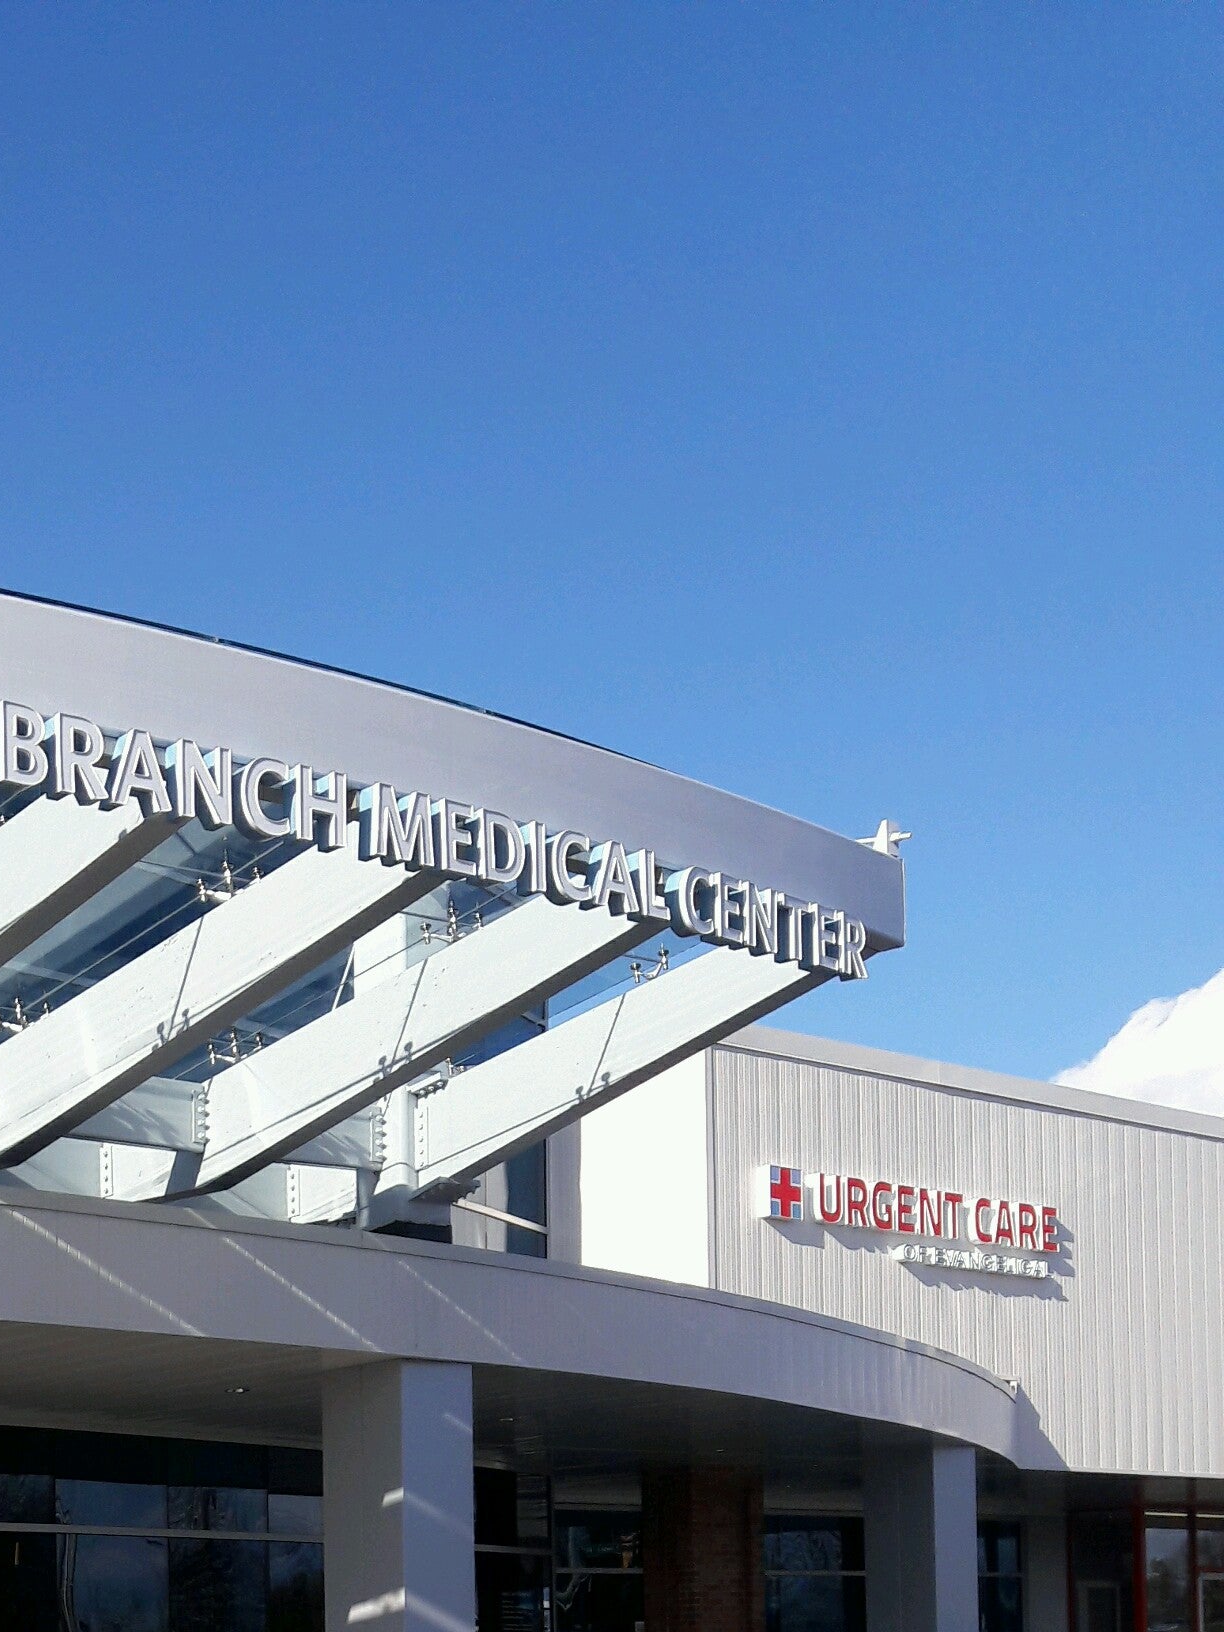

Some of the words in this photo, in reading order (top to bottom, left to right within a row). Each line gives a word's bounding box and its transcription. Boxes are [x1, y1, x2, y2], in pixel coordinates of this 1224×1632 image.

[364, 782, 671, 921] MEDICAL
[670, 865, 869, 981] CENTER
[810, 1172, 964, 1240] URGENT
[971, 1197, 1060, 1253] CARE
[901, 1244, 928, 1263] OF
